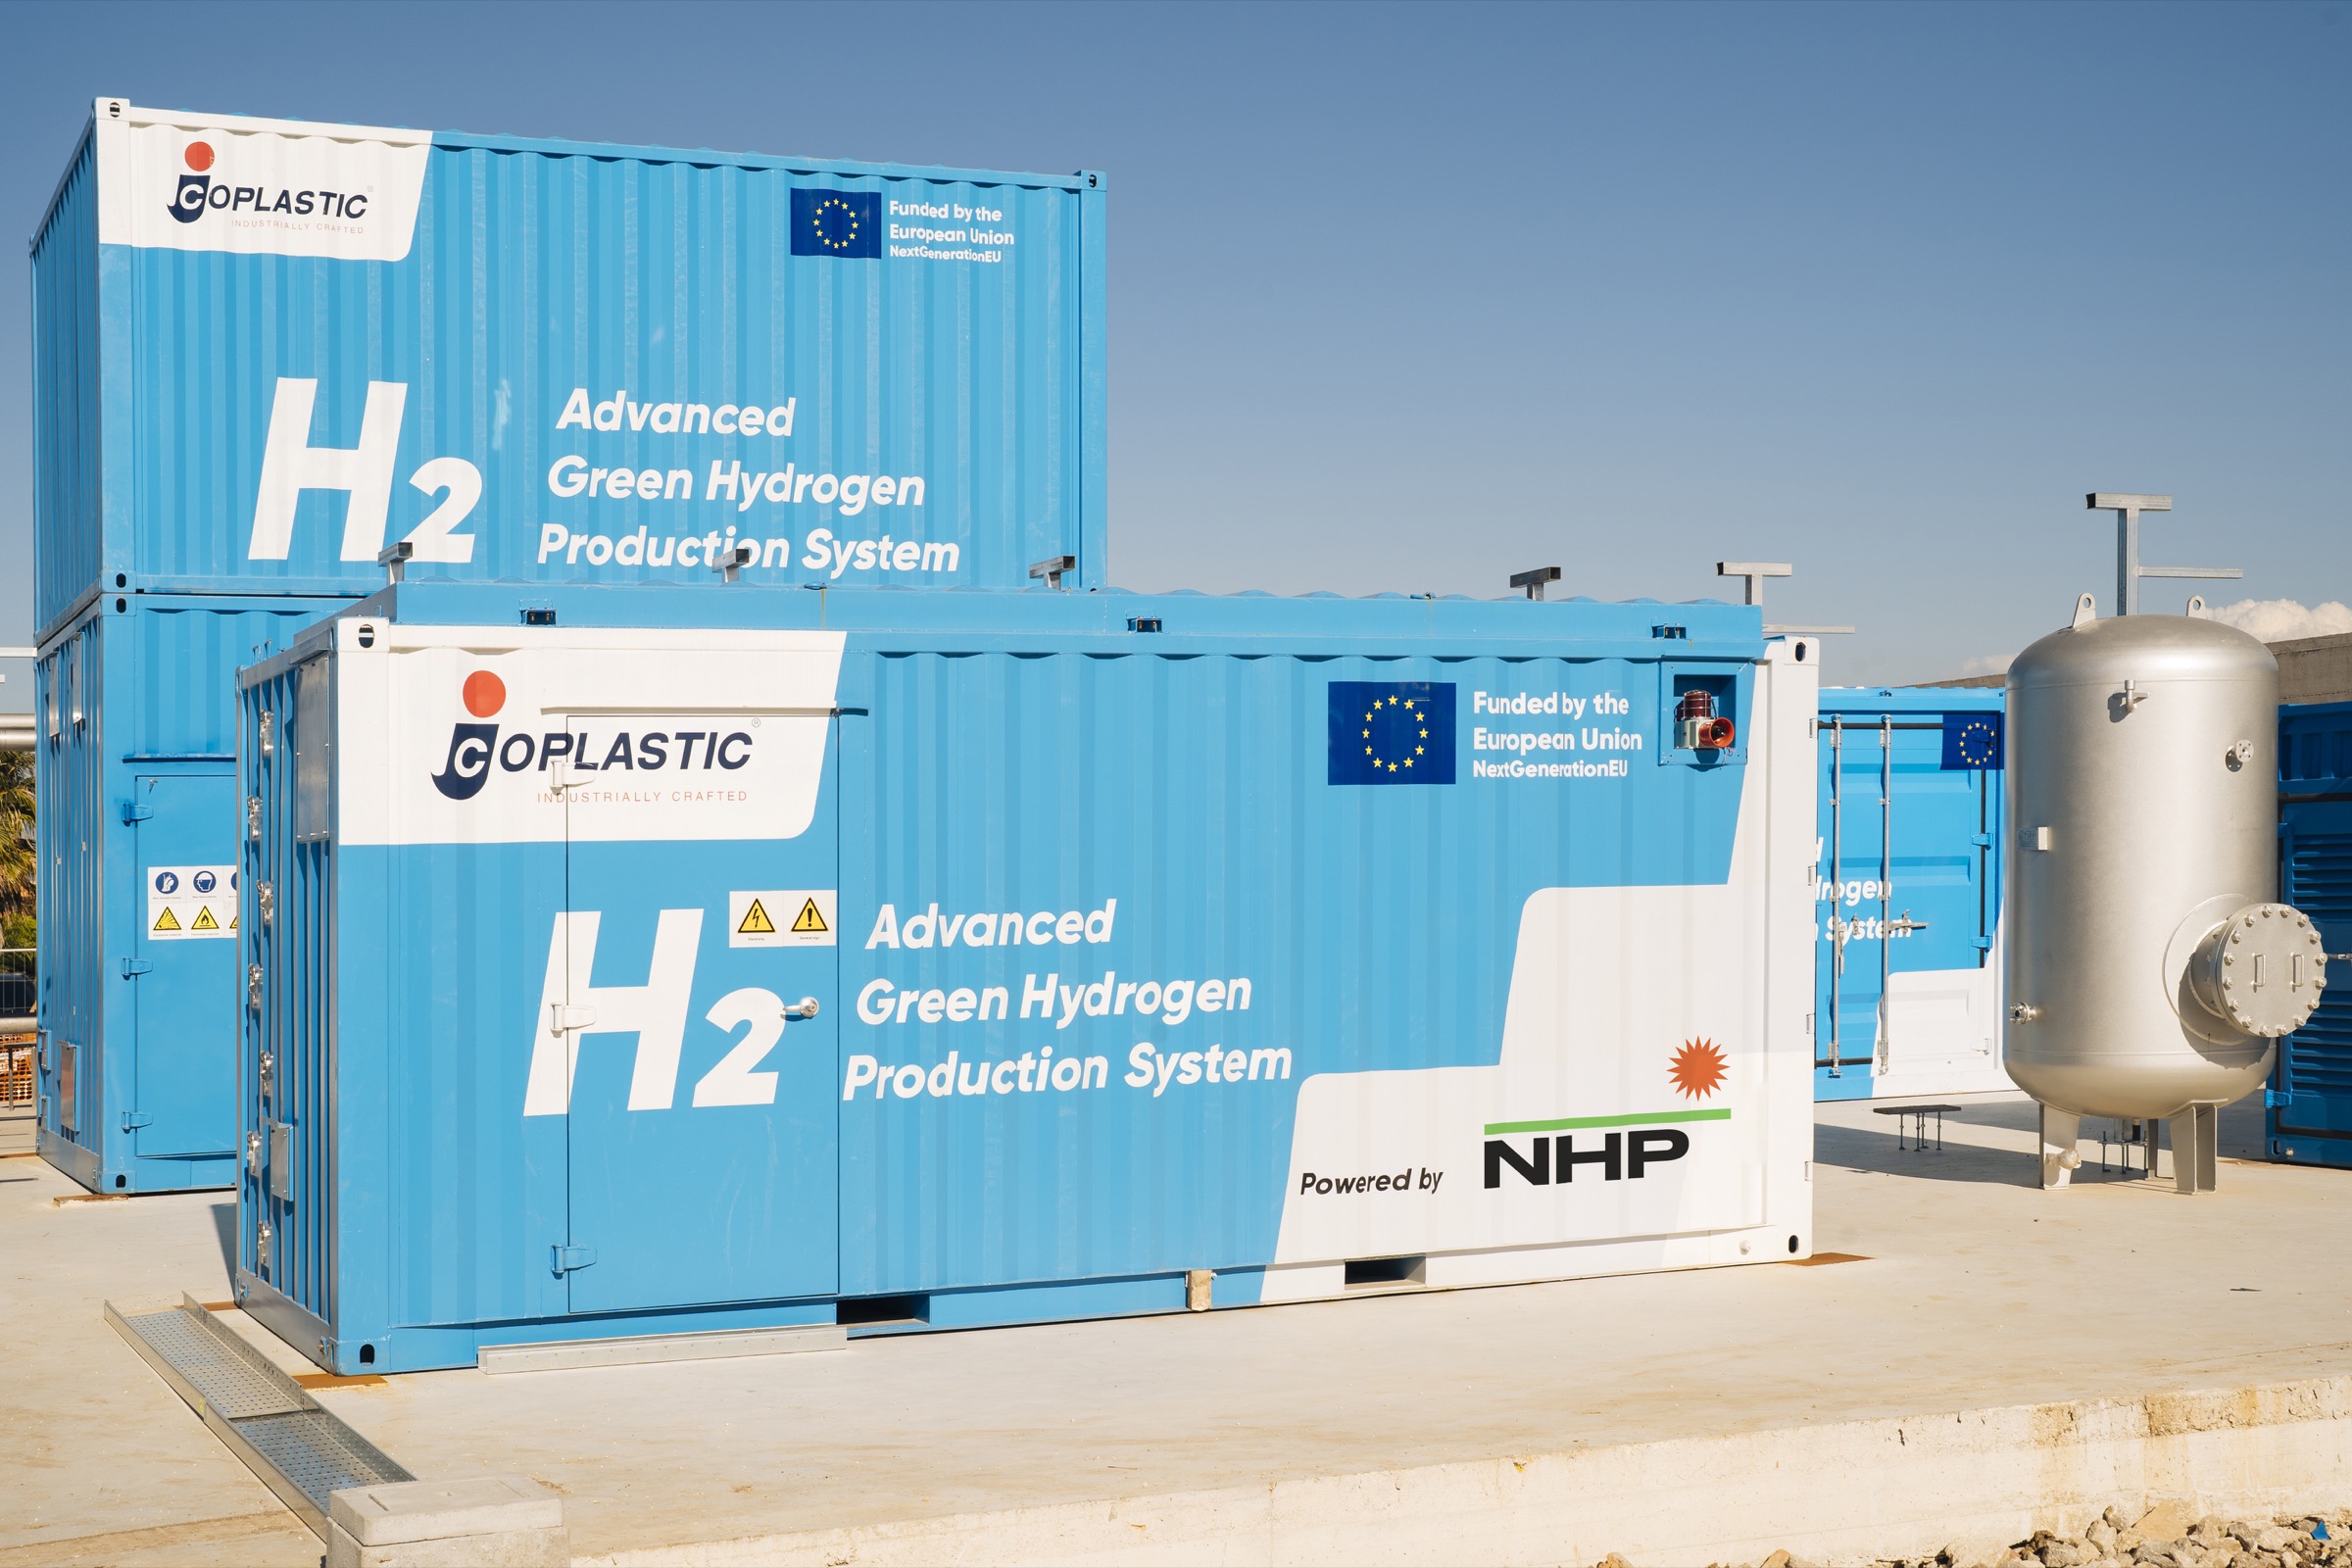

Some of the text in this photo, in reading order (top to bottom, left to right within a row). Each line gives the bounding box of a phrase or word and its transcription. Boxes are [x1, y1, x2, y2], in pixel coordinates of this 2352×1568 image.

[230, 219, 365, 234] INDUSTRIALLY CRAFTED
[889, 200, 1003, 223] Funded by the
[889, 223, 1015, 245] European Union
[889, 245, 1002, 264] NextGenerationEU
[555, 387, 797, 437] Advanced
[248, 376, 482, 564] H2
[547, 455, 926, 516] Green Hydrogen
[537, 522, 960, 580] Production System
[1473, 690, 1629, 721] Funded by the
[1473, 727, 1642, 757] European Union
[1473, 760, 1628, 779] NextGenerationEU
[537, 790, 748, 804] INDUSTRIALLY CRAFTED
[864, 898, 1117, 950] Advanced
[522, 907, 787, 1117] H2
[857, 971, 1252, 1030] Green Hydrogen
[842, 1042, 1293, 1102] Production System
[1484, 1129, 1690, 1190] NHP
[1300, 1167, 1445, 1196] Powered by
